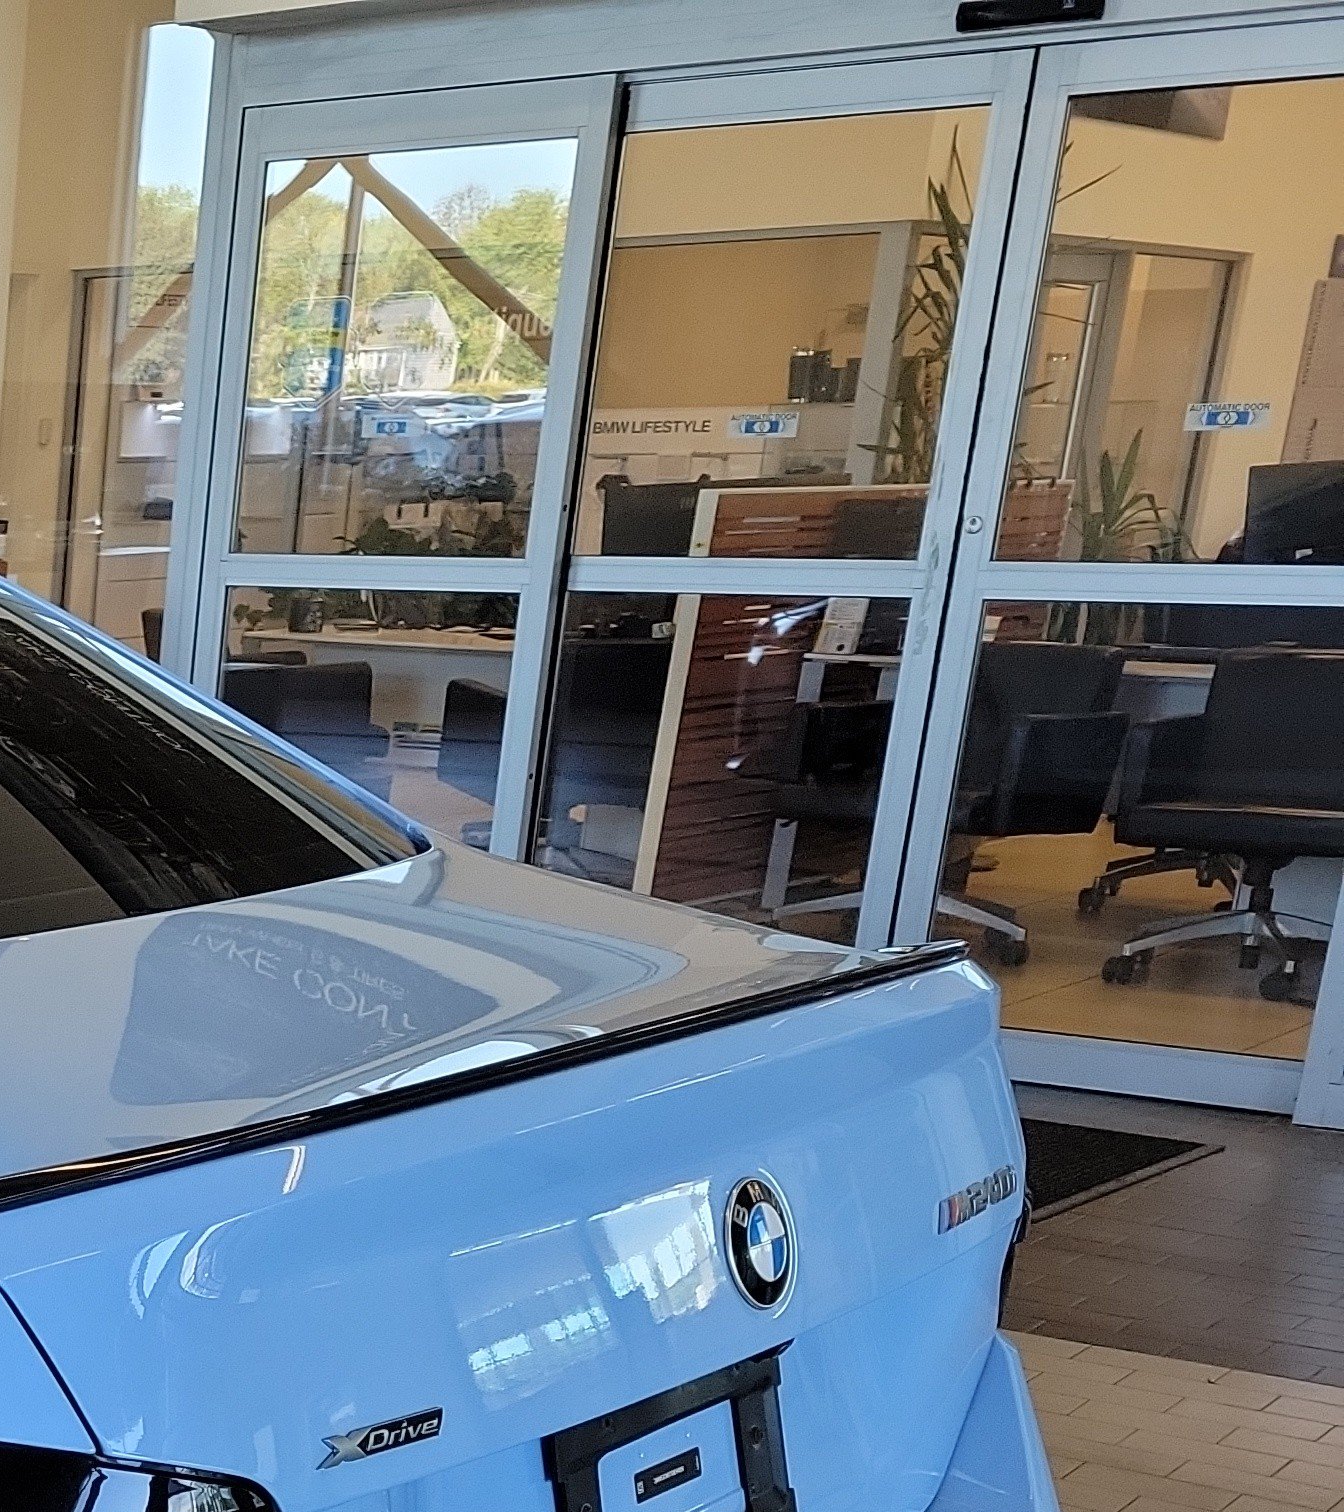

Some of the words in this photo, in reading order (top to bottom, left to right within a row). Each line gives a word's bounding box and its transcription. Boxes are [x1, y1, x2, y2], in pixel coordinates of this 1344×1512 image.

[1243, 402, 1270, 411] DOOR
[592, 421, 630, 434] BMW
[631, 420, 711, 434] LIFESTYLE
